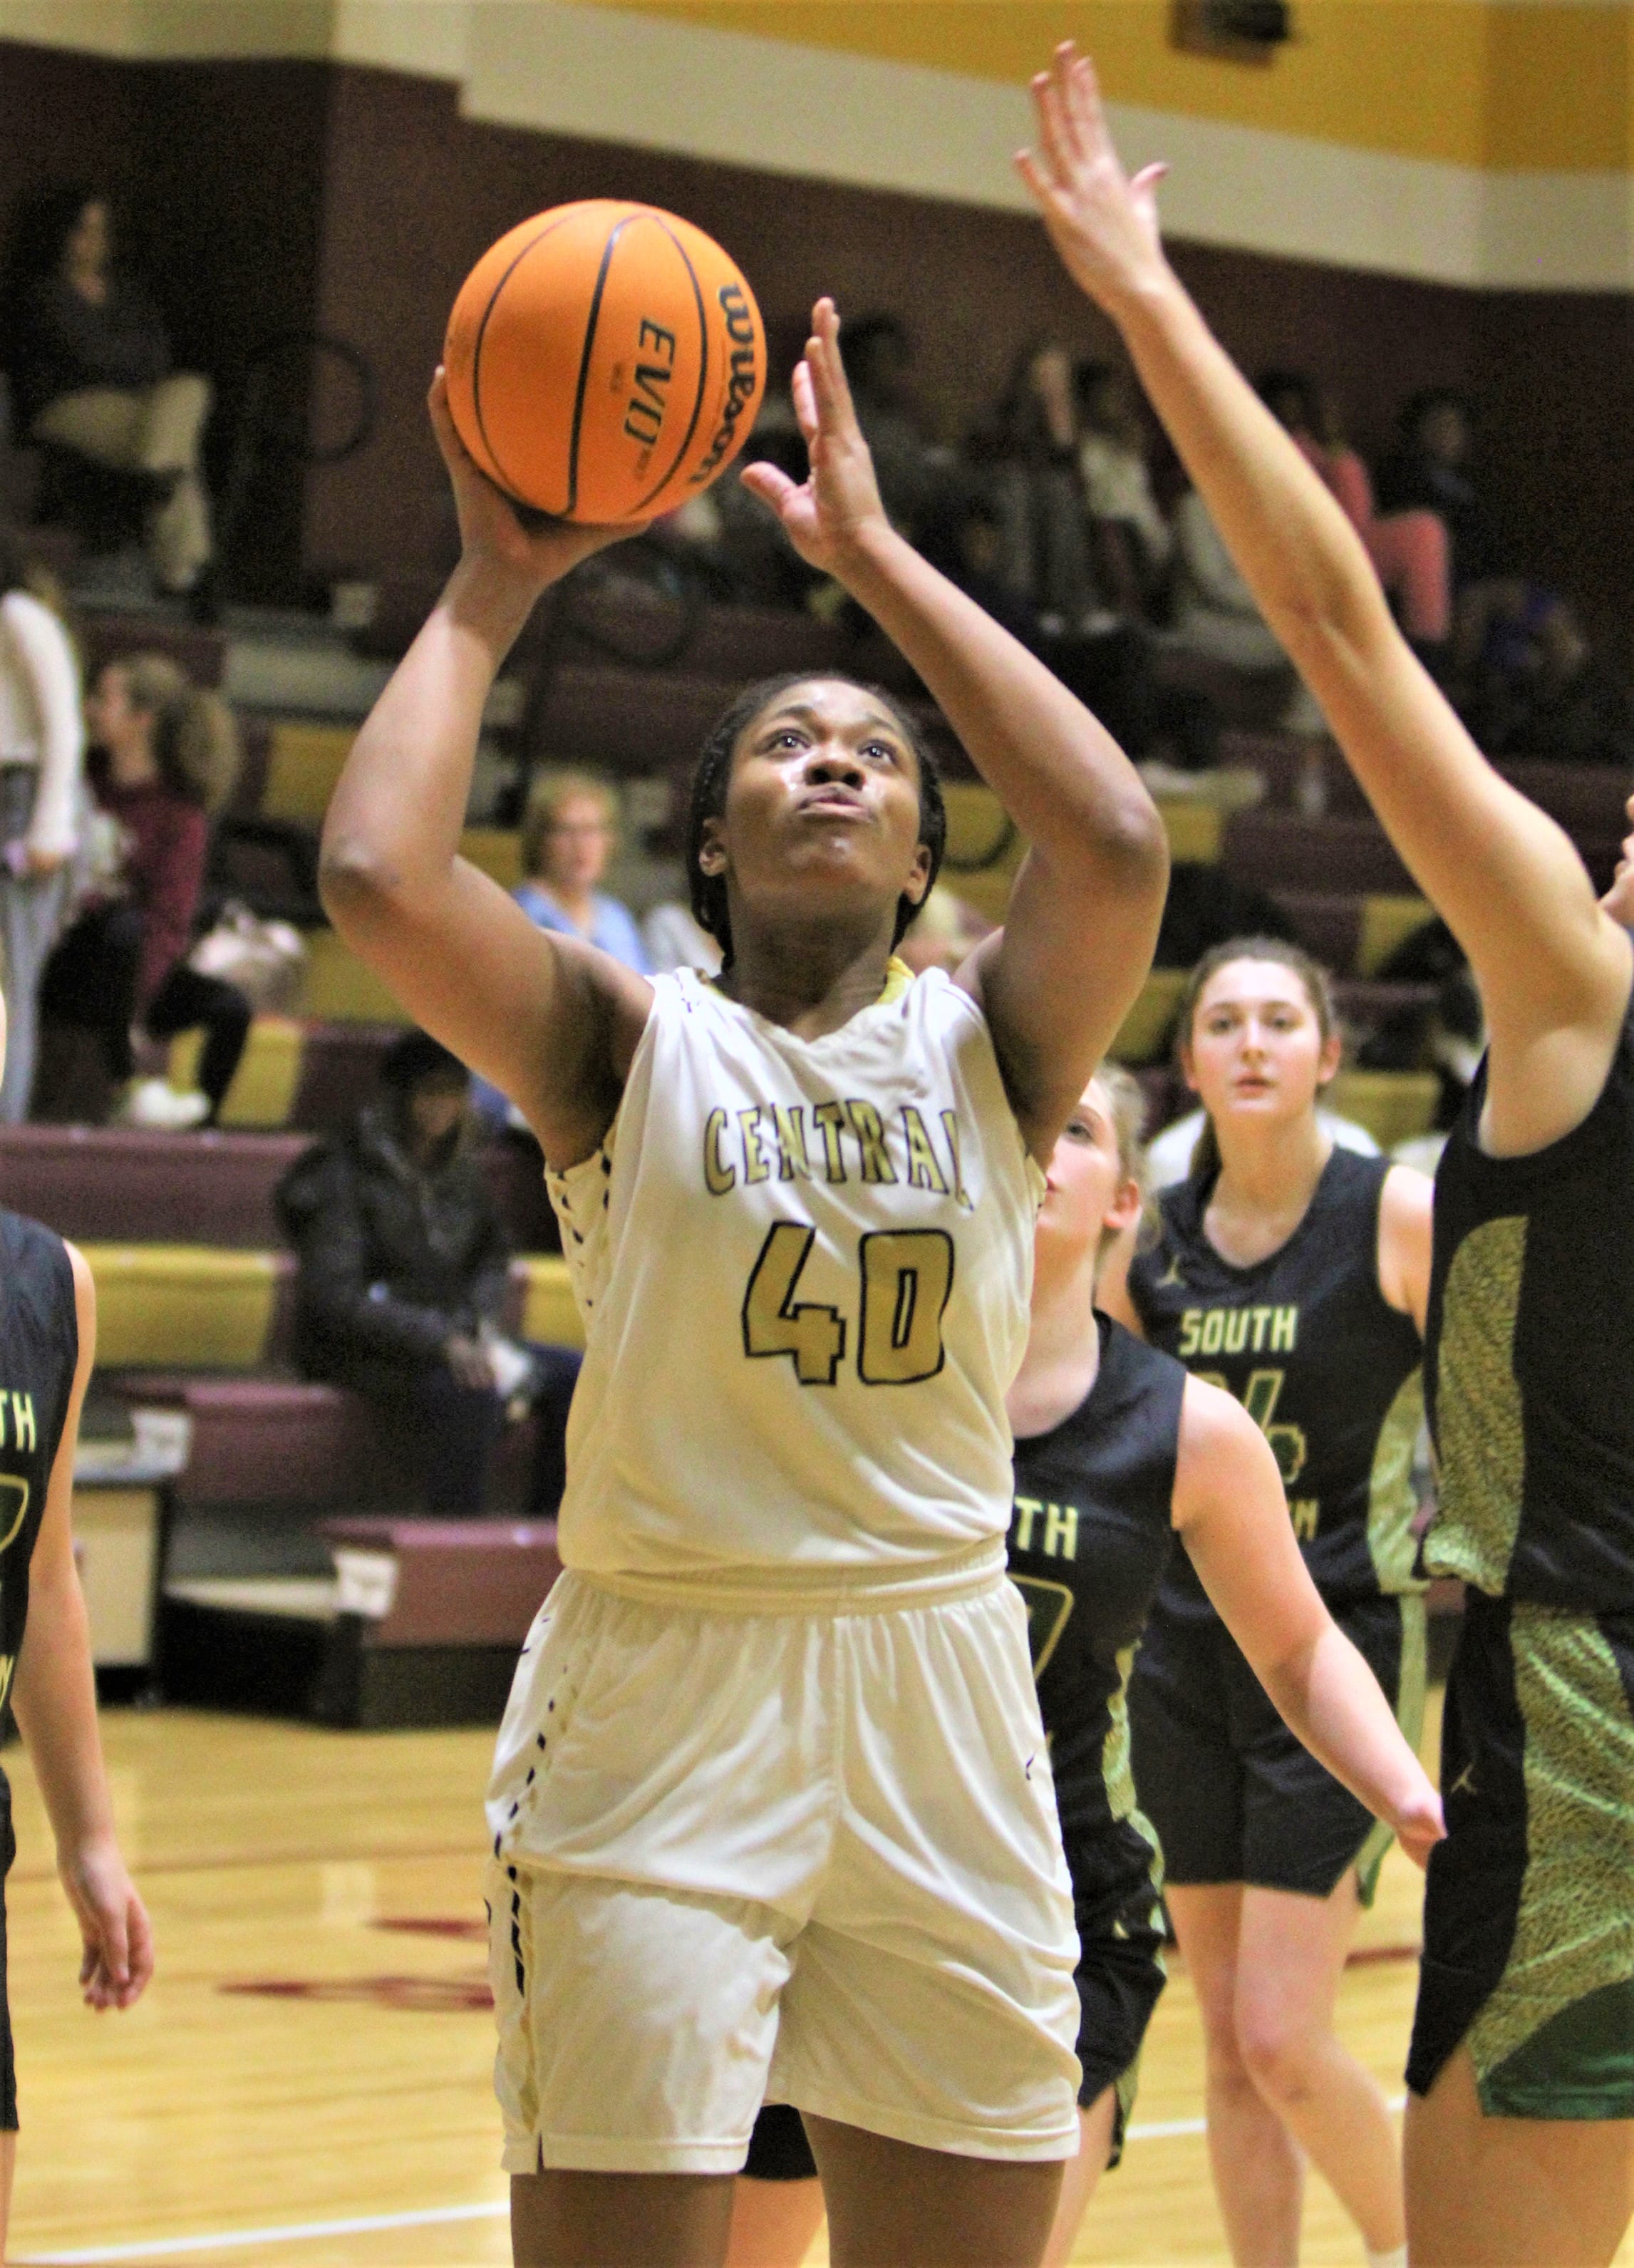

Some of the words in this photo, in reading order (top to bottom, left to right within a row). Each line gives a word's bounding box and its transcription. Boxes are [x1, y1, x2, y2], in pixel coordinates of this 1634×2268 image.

[624, 319, 676, 445] EVO
[740, 1220, 955, 1386] 40
[1179, 1306, 1298, 1355] SOUTH
